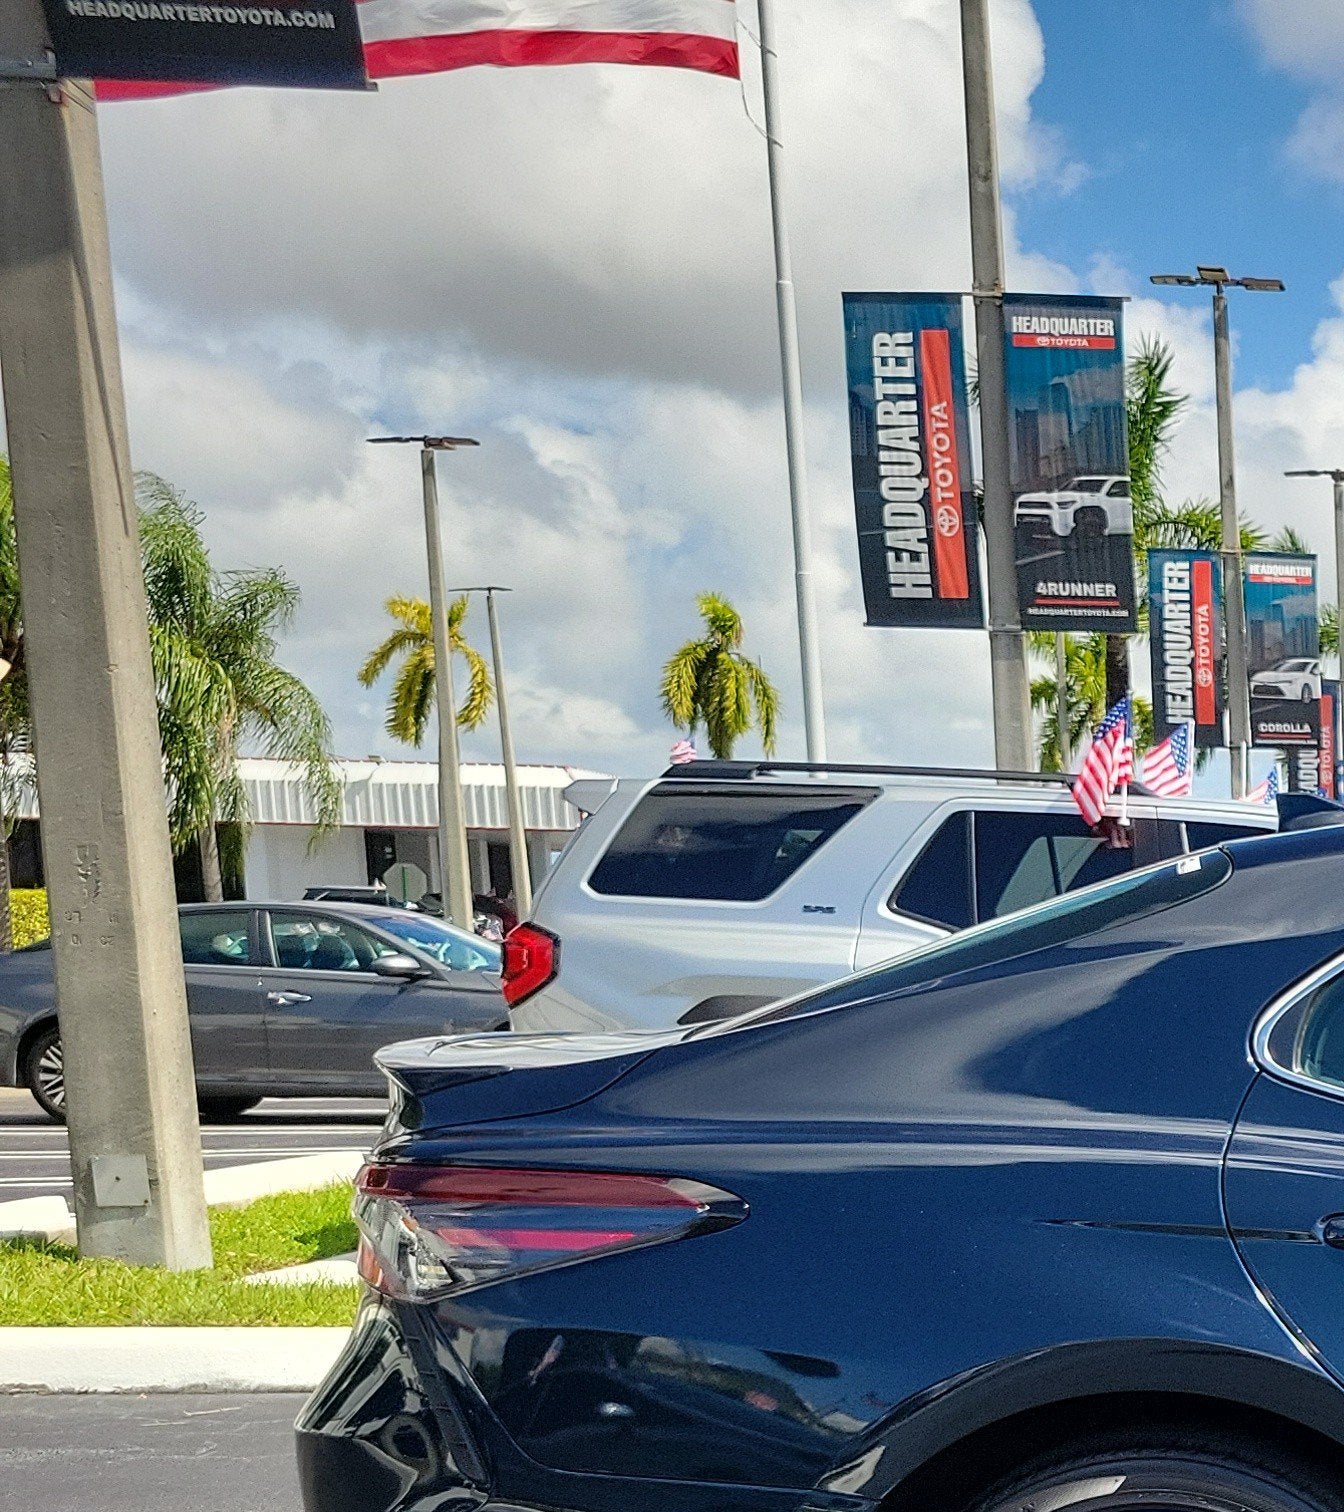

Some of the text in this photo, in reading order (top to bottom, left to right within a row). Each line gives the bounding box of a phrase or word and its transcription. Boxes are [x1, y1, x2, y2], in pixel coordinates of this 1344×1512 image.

[66, 0, 335, 28] HEADQUARTERTOYOTA.COM
[1012, 316, 1114, 336] HEADQUARTER
[1050, 338, 1089, 346] TOYOTA
[873, 331, 934, 599] HEADQUARTER
[930, 401, 952, 502] TOYOTA
[1036, 582, 1117, 597] 4RUNNER
[1163, 561, 1194, 723] HEADQUARTER
[1196, 604, 1211, 668] TOYOTA
[1258, 722, 1312, 733] COROLLA
